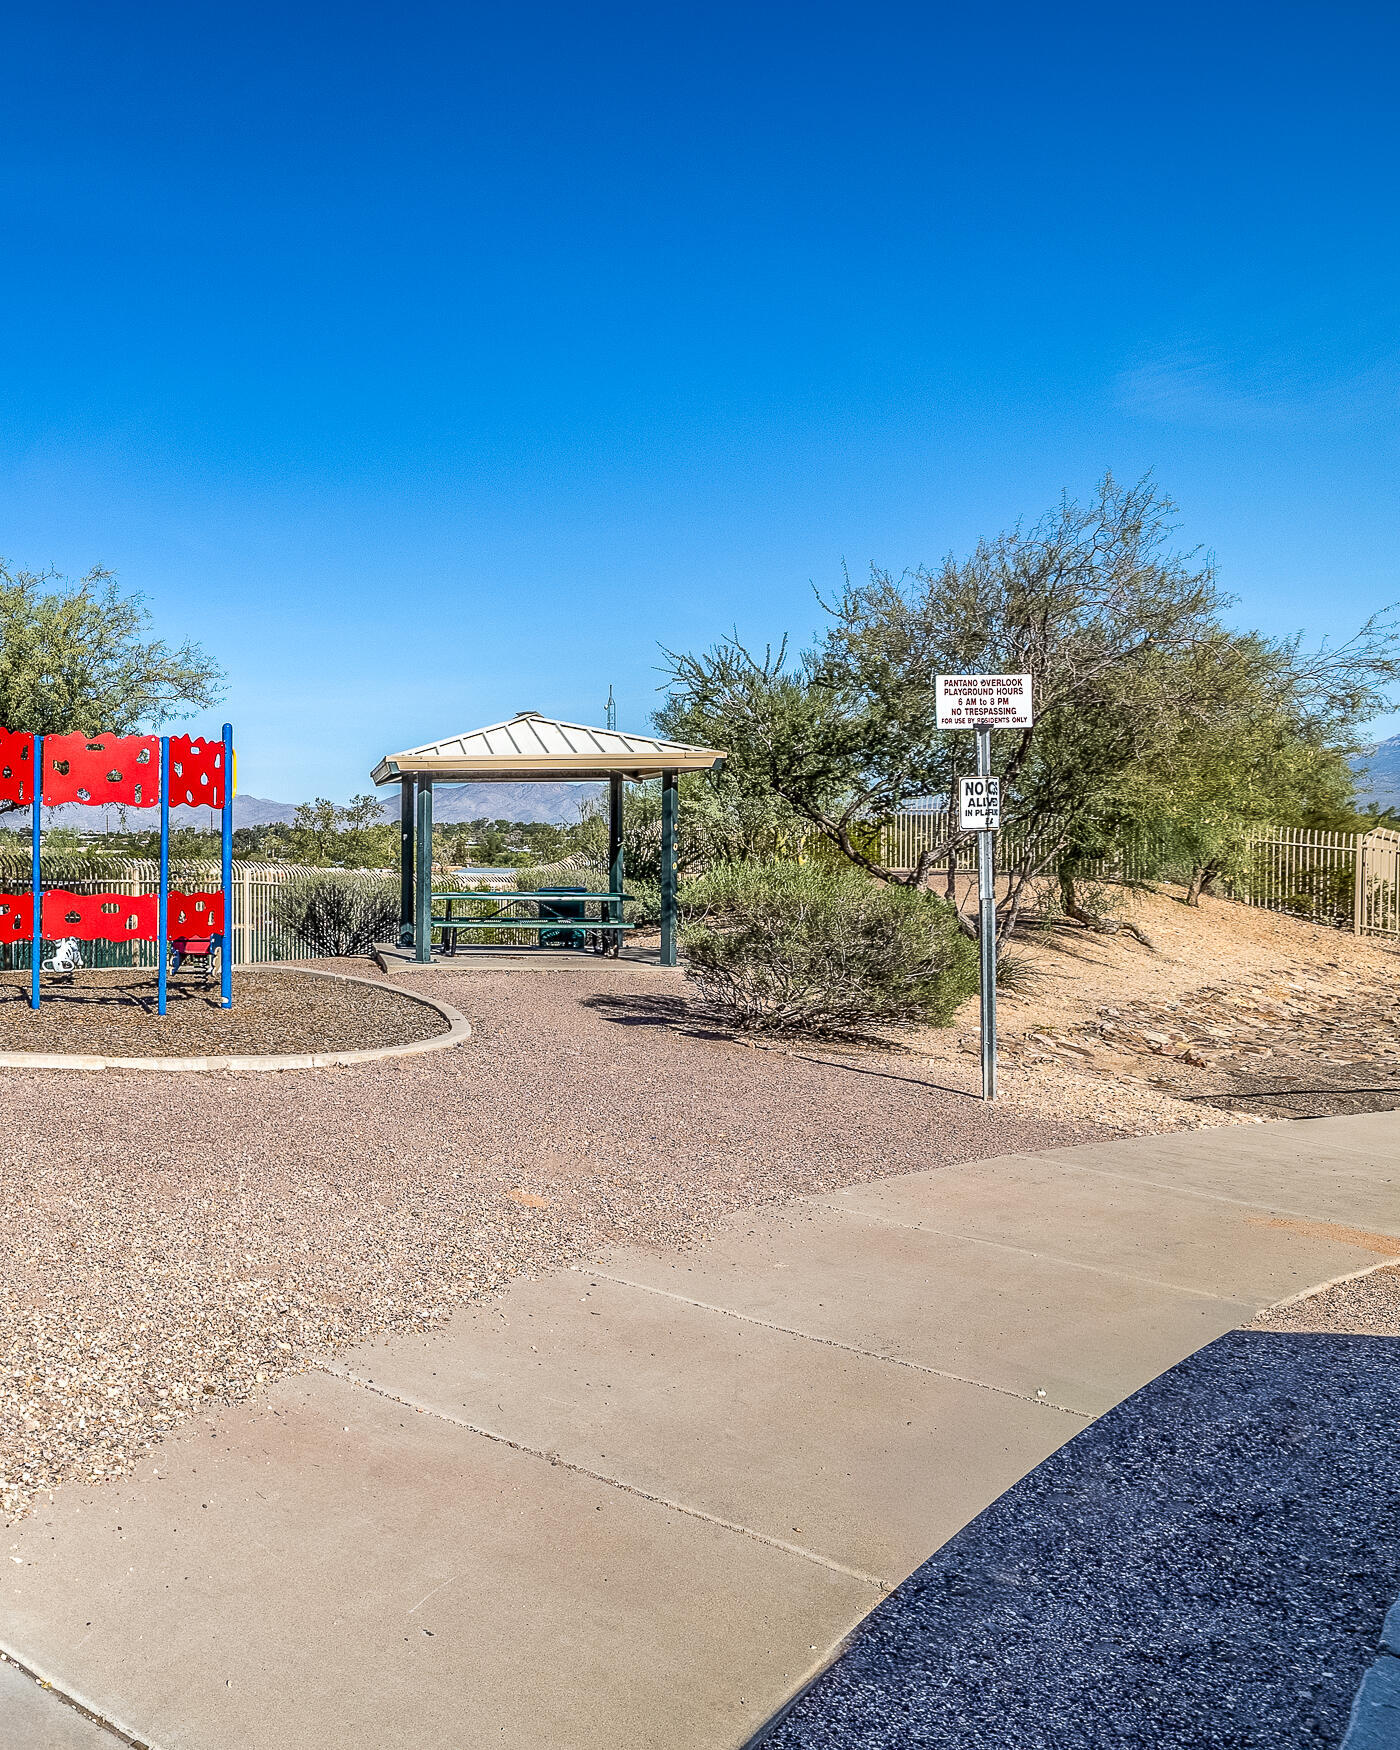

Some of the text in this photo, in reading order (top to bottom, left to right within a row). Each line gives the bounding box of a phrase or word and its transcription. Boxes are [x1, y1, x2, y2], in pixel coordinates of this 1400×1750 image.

[943, 678, 1023, 687] PANTANO OVERLOOK
[943, 687, 1024, 696] PLAYGROUND HOURS
[957, 697, 963, 706] 6
[965, 697, 977, 706] AM
[979, 697, 988, 706] to
[997, 697, 1009, 706] PM
[951, 707, 1017, 716] NO TRESPASSING
[965, 781, 984, 796] NO
[964, 809, 973, 817] IN
